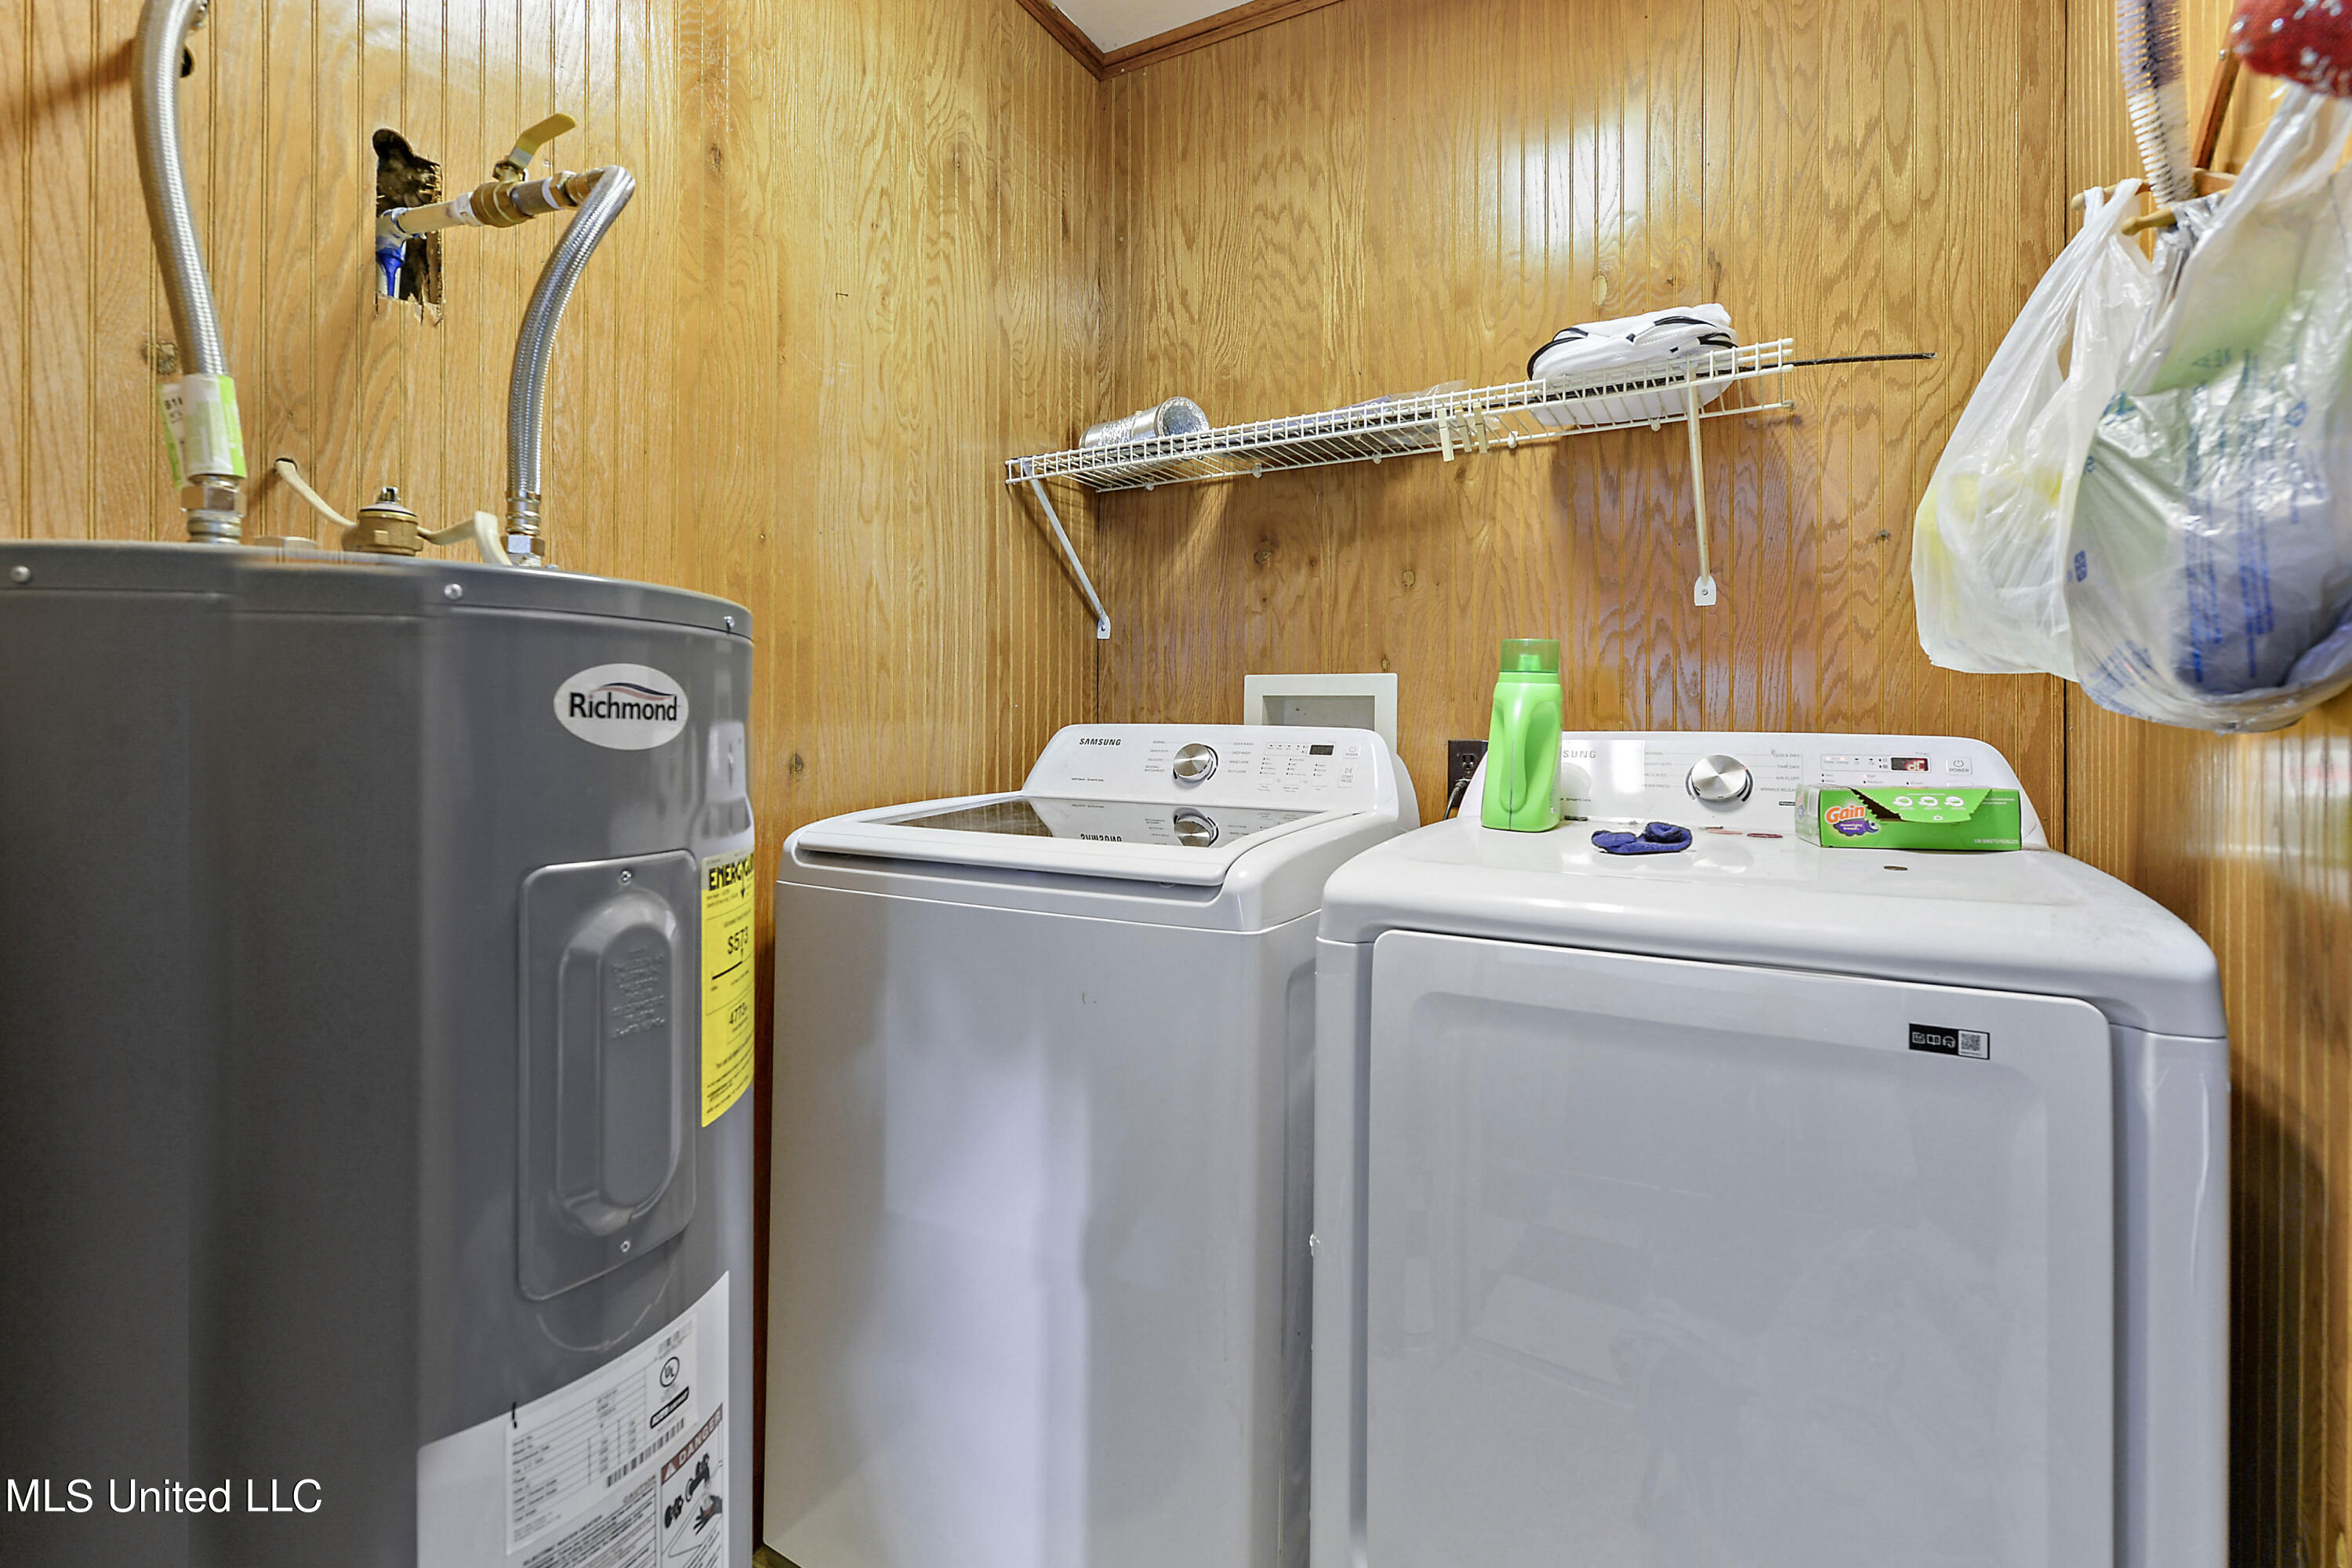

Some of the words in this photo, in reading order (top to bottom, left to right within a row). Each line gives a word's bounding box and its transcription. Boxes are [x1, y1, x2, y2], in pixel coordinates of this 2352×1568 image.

[569, 691, 677, 720] Richmond
[1079, 738, 1122, 746] SAMSUNG
[1563, 750, 1597, 758] SUNG
[1825, 804, 1866, 823] Gain
[678, 1403, 723, 1465] DANGER
